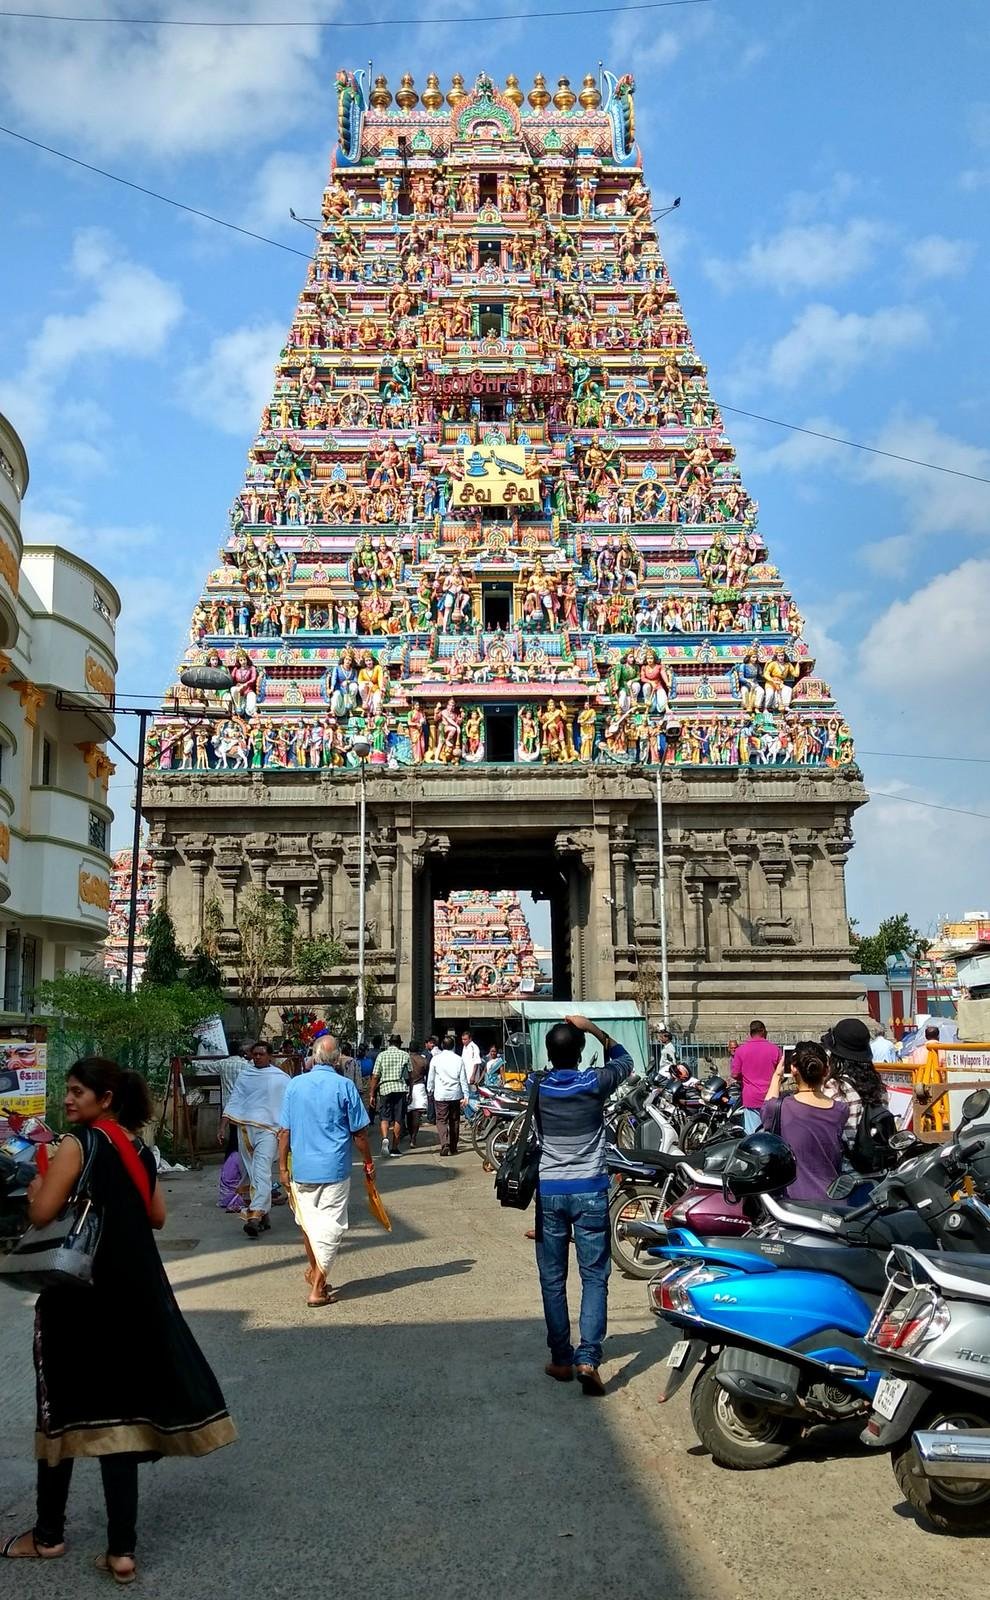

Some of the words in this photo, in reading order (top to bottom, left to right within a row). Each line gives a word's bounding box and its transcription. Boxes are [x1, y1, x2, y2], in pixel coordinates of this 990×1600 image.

[460, 482, 491, 503] சிவ
[503, 482, 534, 502] சிவ
[960, 1054, 981, 1067] Mylapore
